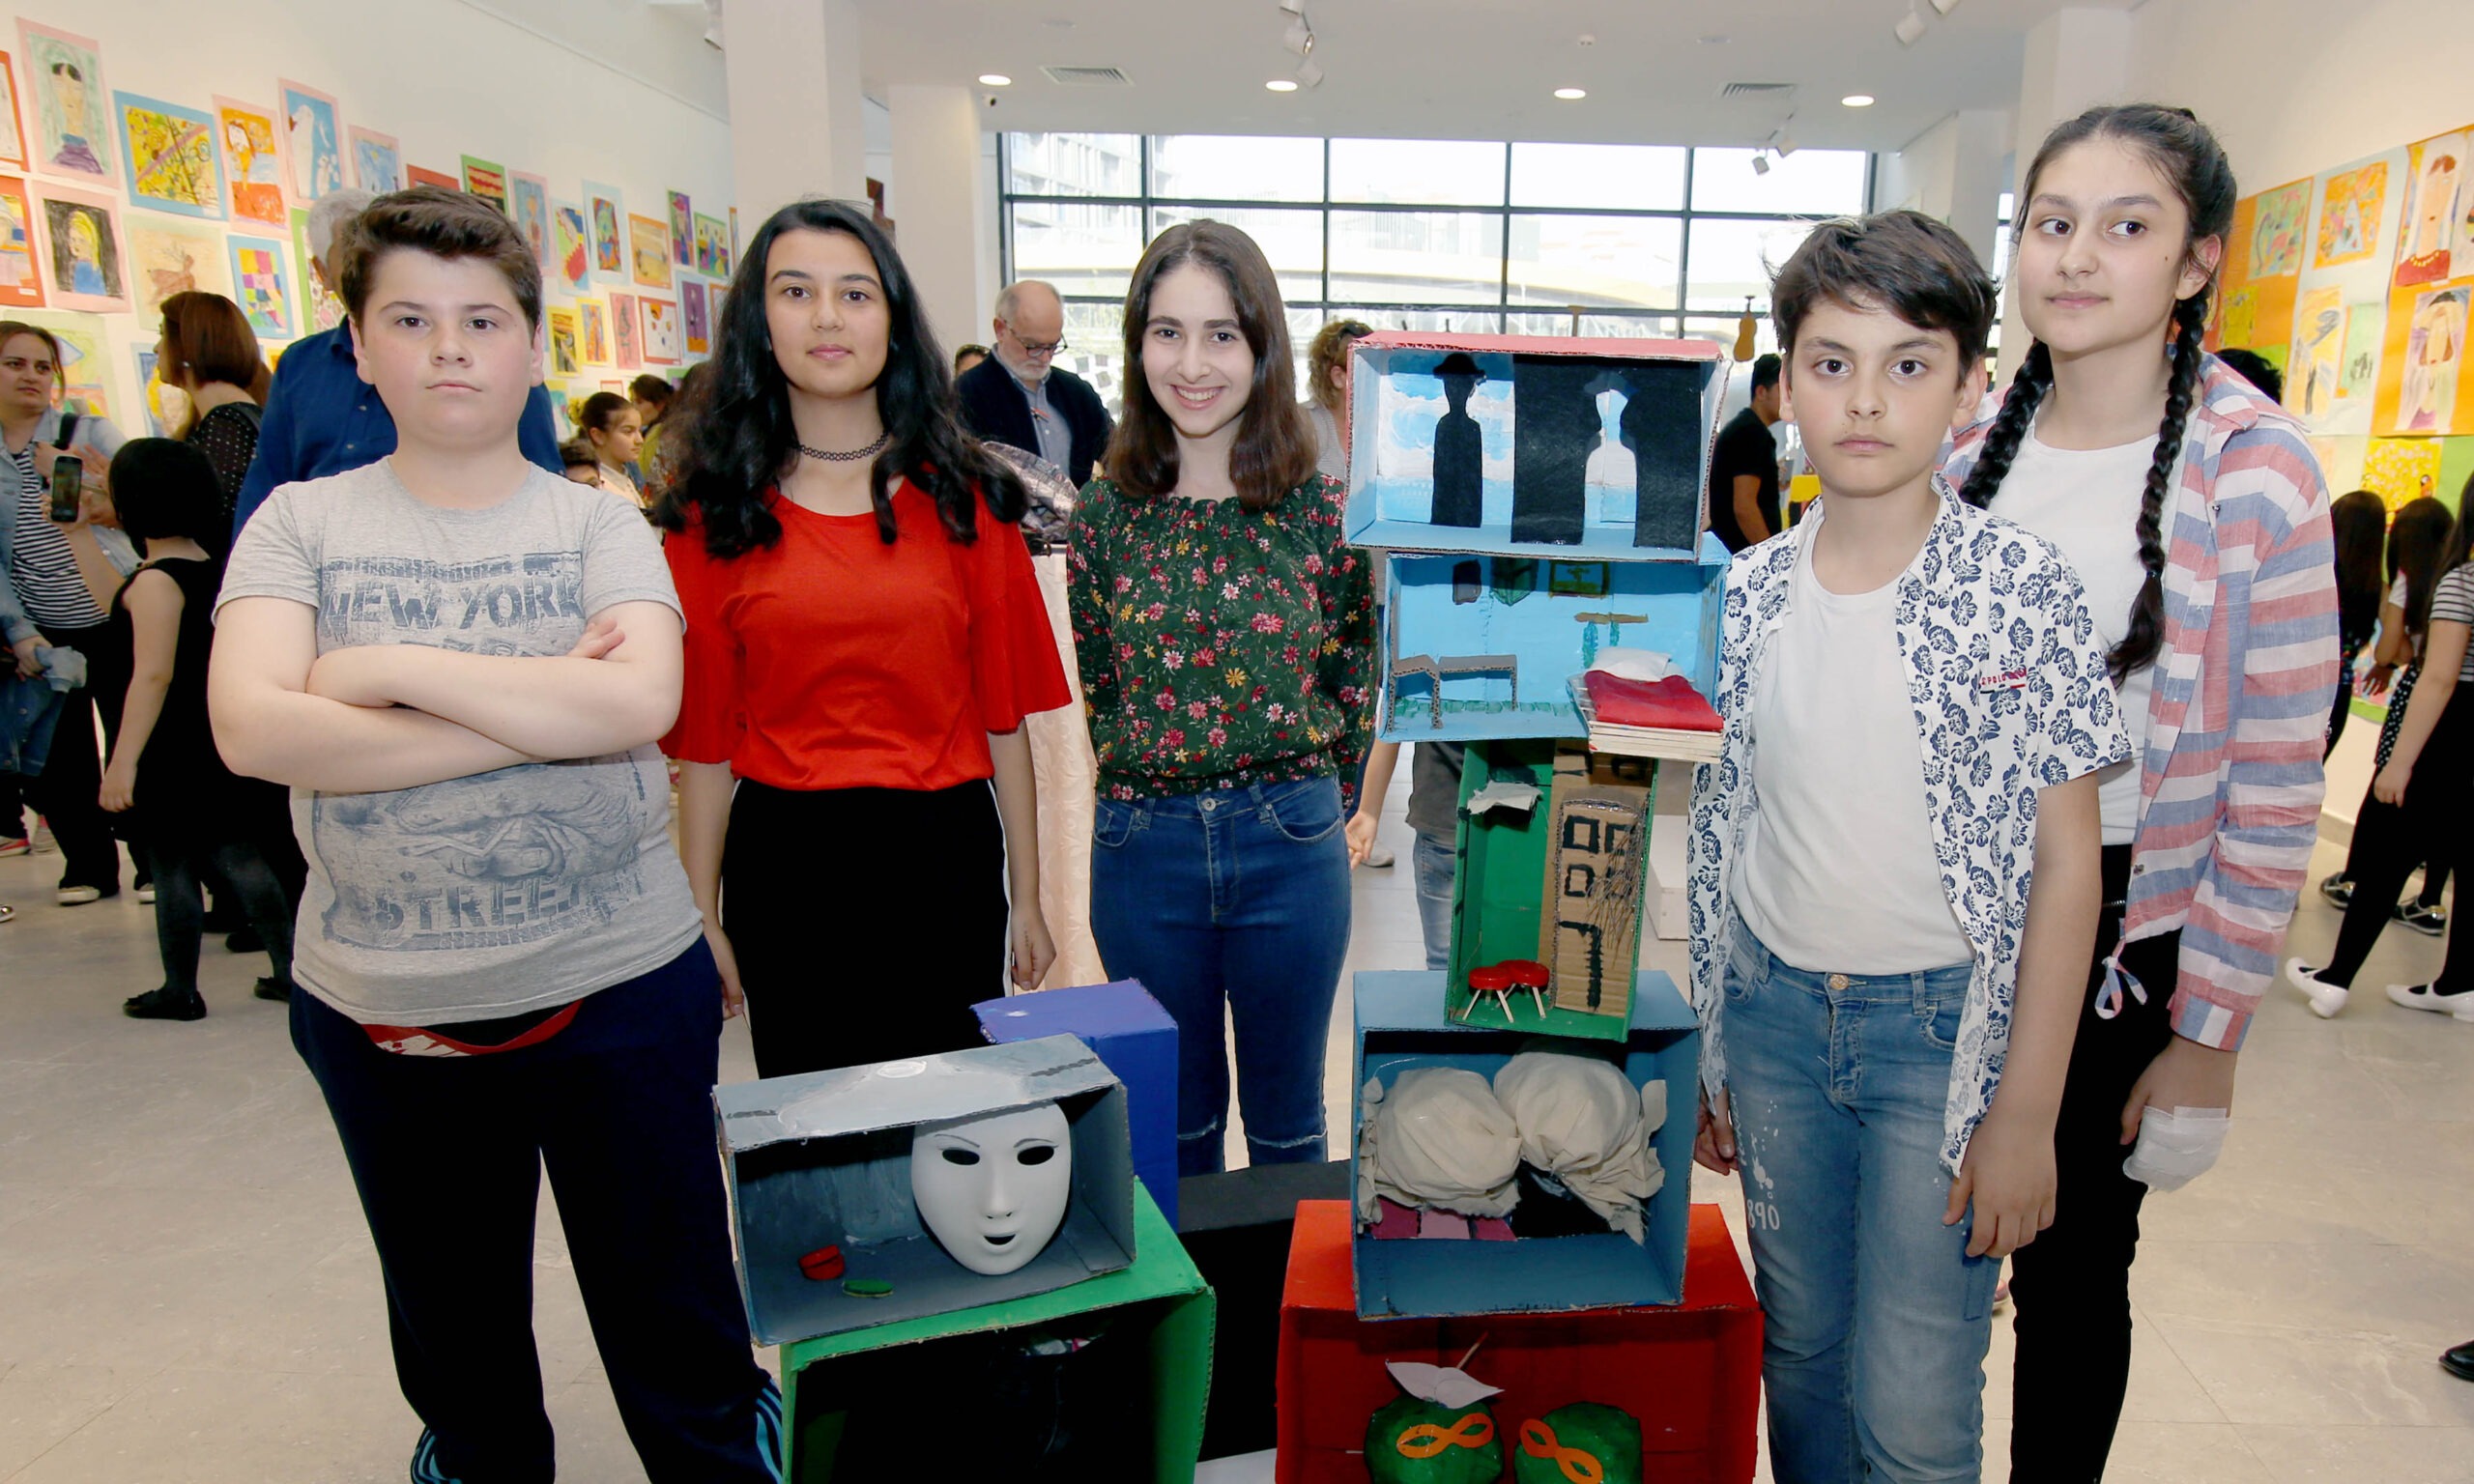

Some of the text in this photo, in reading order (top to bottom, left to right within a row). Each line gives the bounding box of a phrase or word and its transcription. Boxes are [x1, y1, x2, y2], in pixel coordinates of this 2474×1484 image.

[320, 577, 586, 633] NEW YORK
[375, 875, 582, 929] STREET
